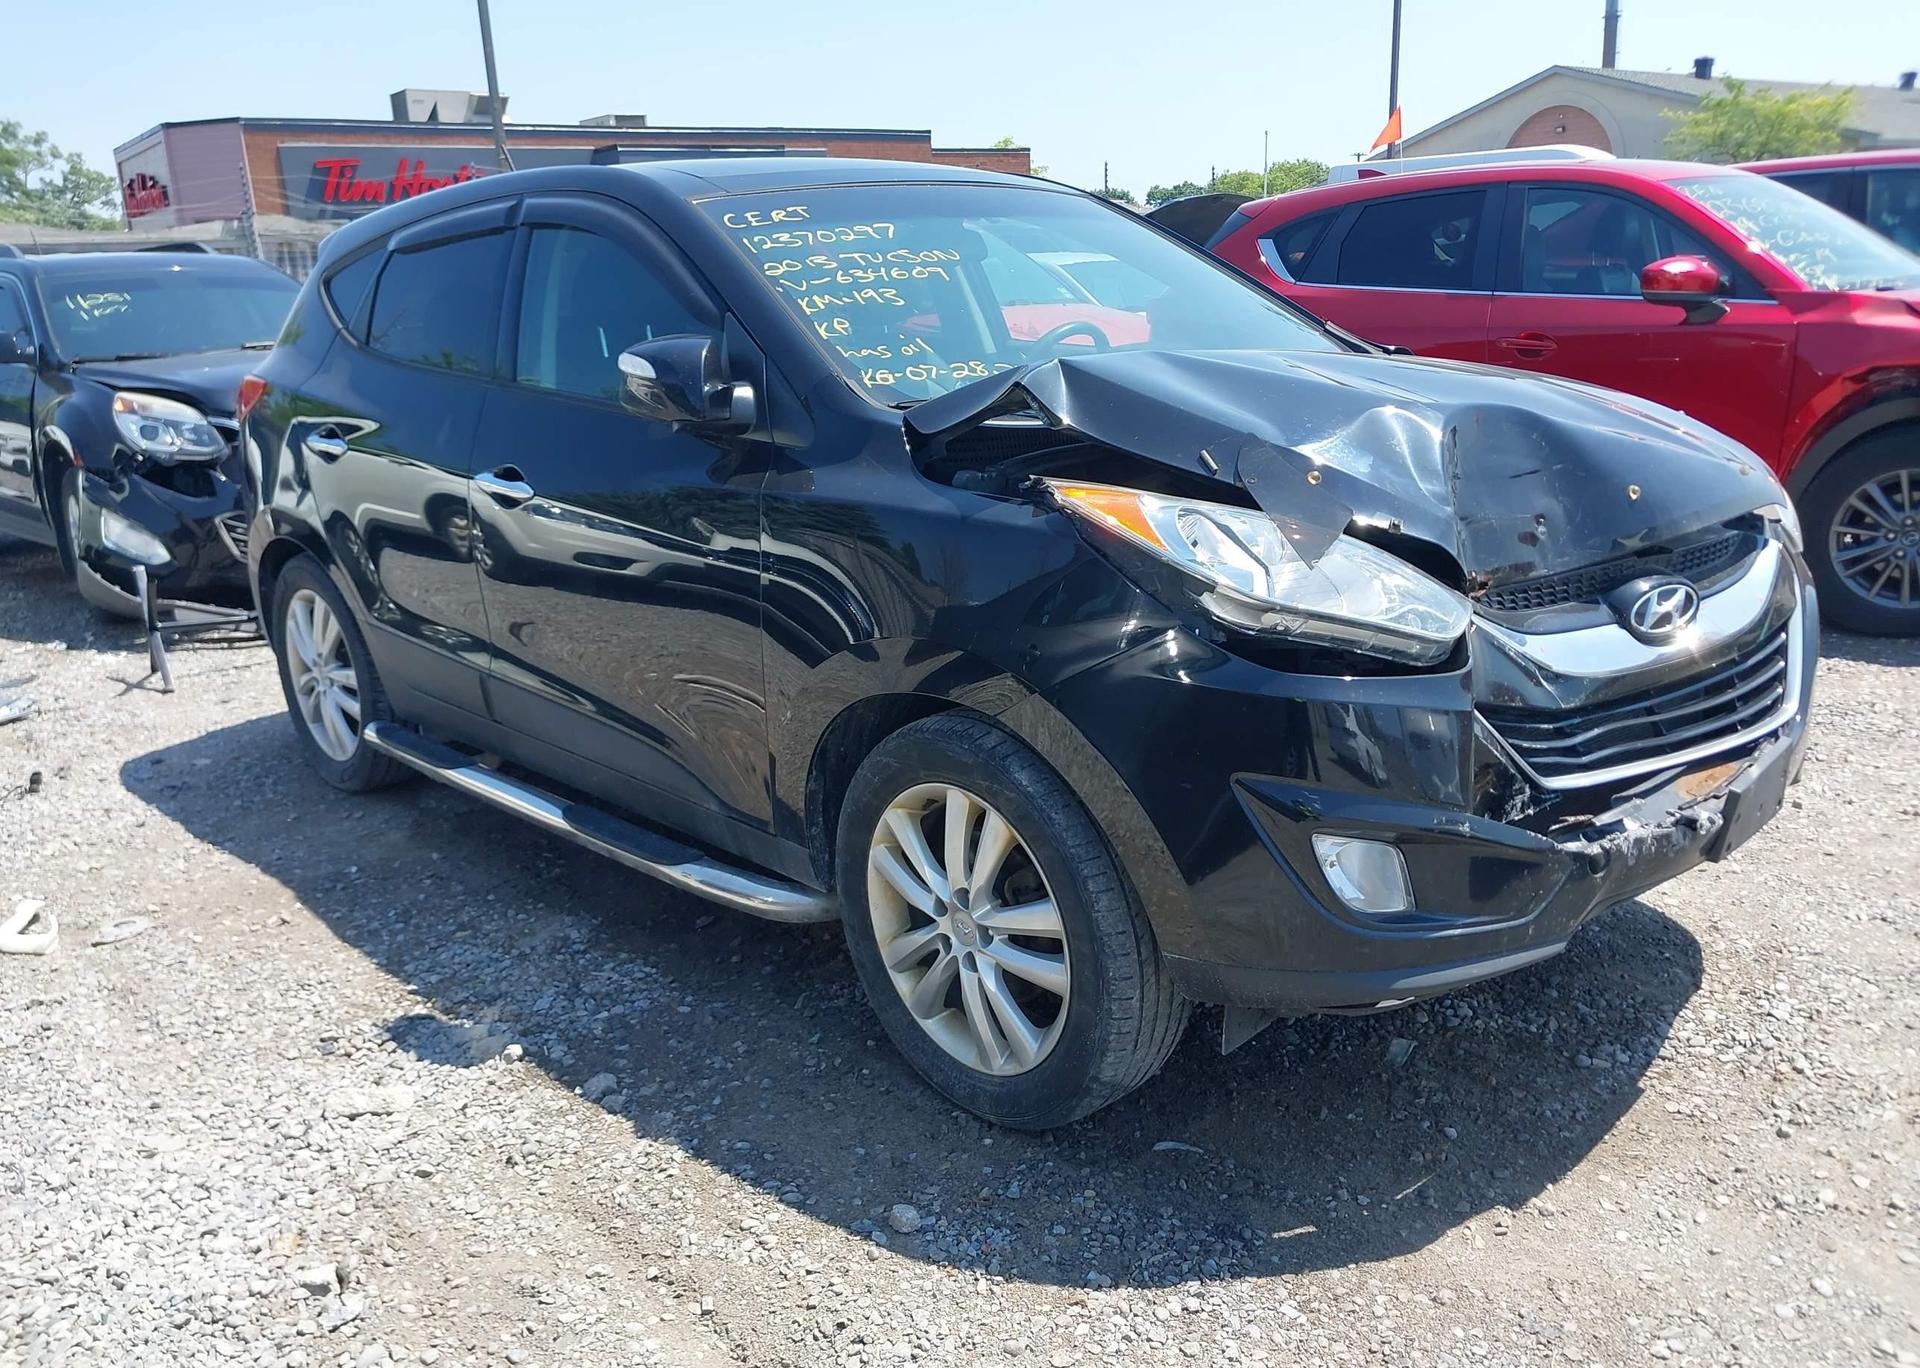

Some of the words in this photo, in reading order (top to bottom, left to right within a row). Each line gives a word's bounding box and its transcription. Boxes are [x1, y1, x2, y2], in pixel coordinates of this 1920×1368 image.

[315, 157, 385, 203] Tim
[723, 206, 811, 229] CERT
[742, 223, 896, 254] 12370297
[838, 248, 961, 266] TUCSON
[835, 345, 892, 359] has
[899, 334, 934, 356] oil
